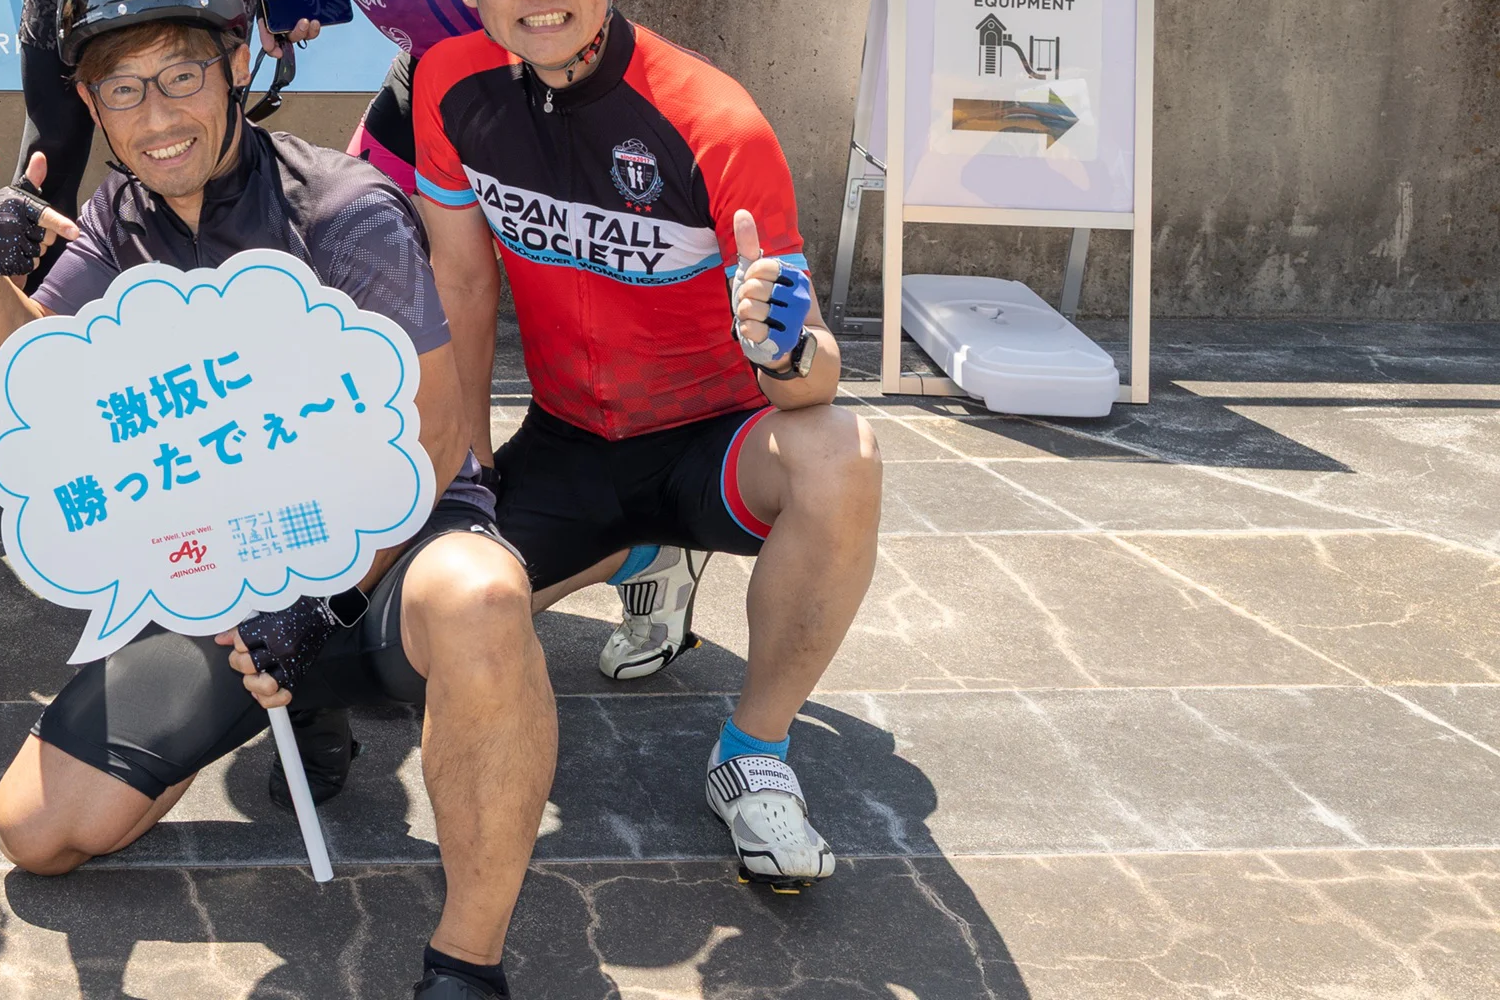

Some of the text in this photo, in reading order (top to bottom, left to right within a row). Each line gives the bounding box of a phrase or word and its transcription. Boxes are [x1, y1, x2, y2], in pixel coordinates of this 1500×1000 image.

[475, 178, 674, 249] JAPAN TALL
[501, 216, 665, 275] SOCIETY
[541, 256, 571, 265] OVER
[96, 351, 253, 443] 激坂に
[151, 537, 163, 545] Eat
[181, 529, 196, 538] Live
[748, 769, 790, 781] SHIMANO
